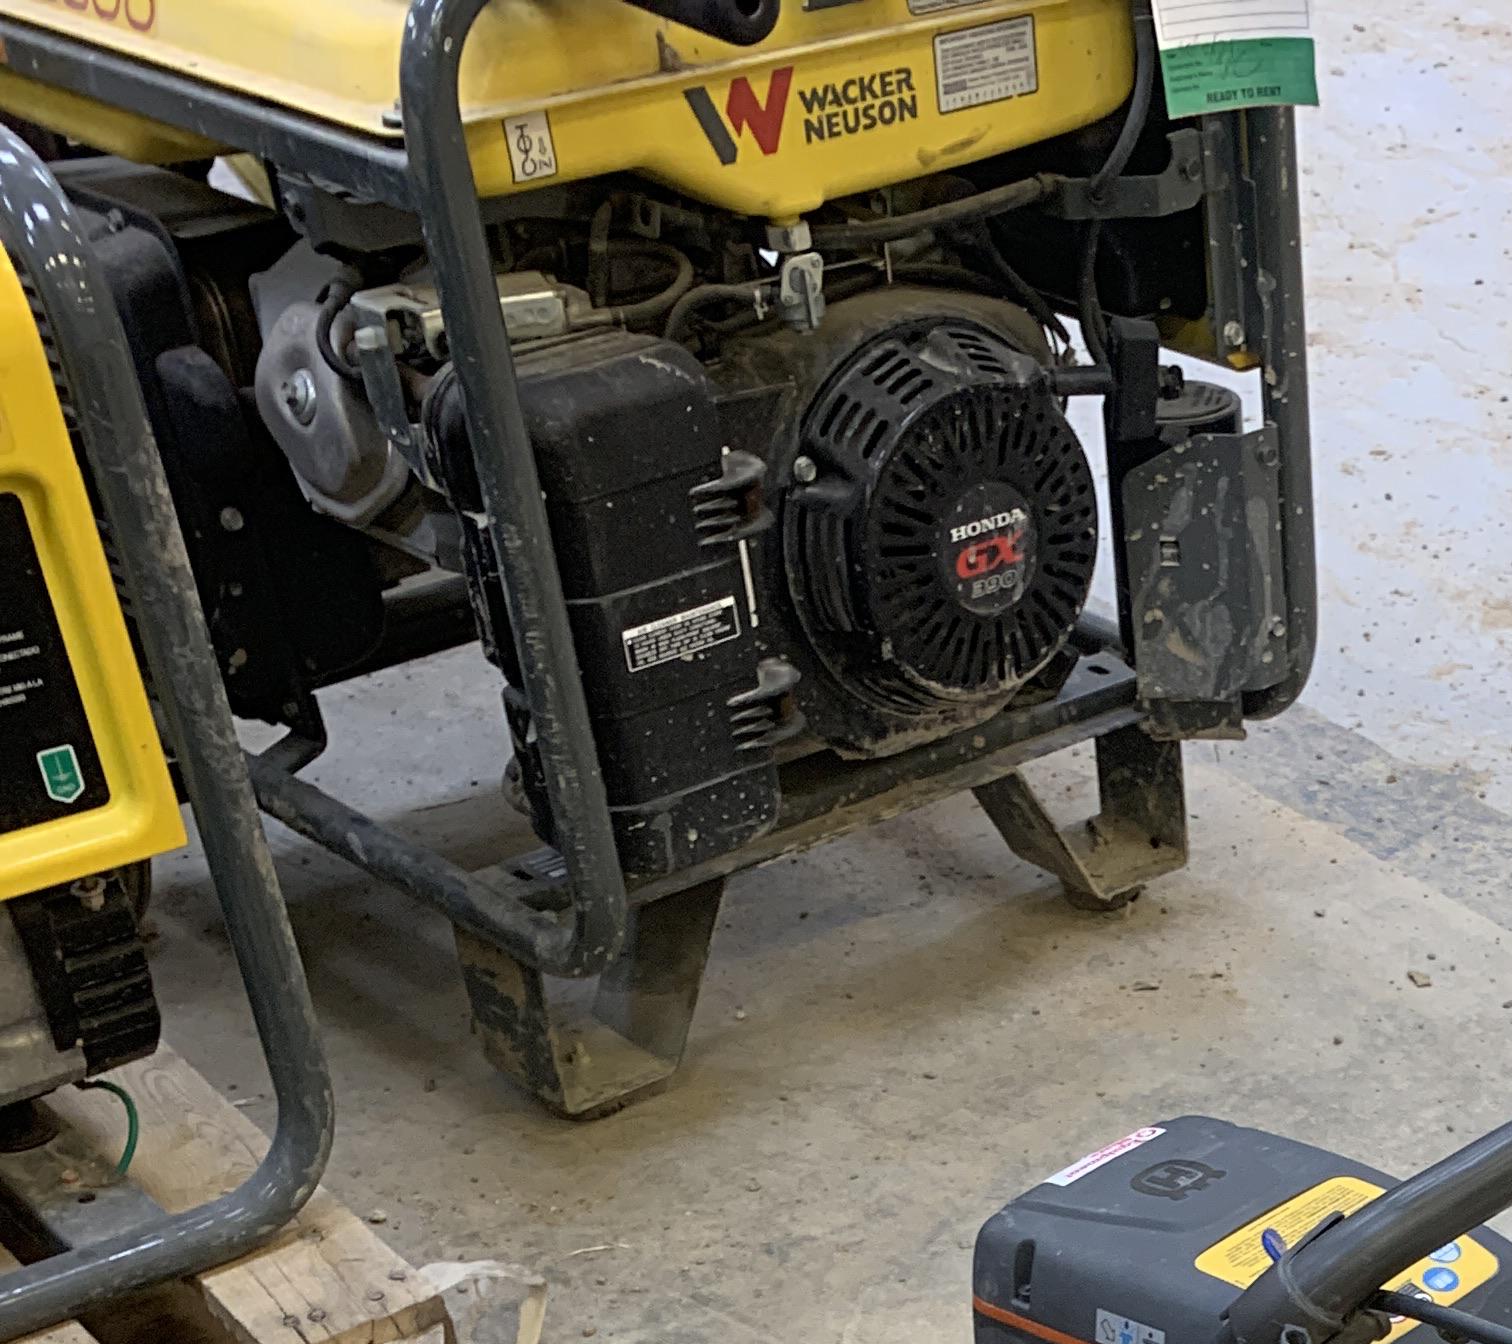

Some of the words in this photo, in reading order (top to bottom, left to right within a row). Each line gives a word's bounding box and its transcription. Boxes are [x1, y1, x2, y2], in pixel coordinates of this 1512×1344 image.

[797, 67, 917, 115] WACKER
[1206, 91, 1238, 103] READY
[1241, 88, 1254, 99] TO
[1256, 86, 1281, 98] RENT
[803, 94, 918, 145] NEUSON
[950, 508, 1027, 543] HONDA
[956, 528, 1024, 578] GX
